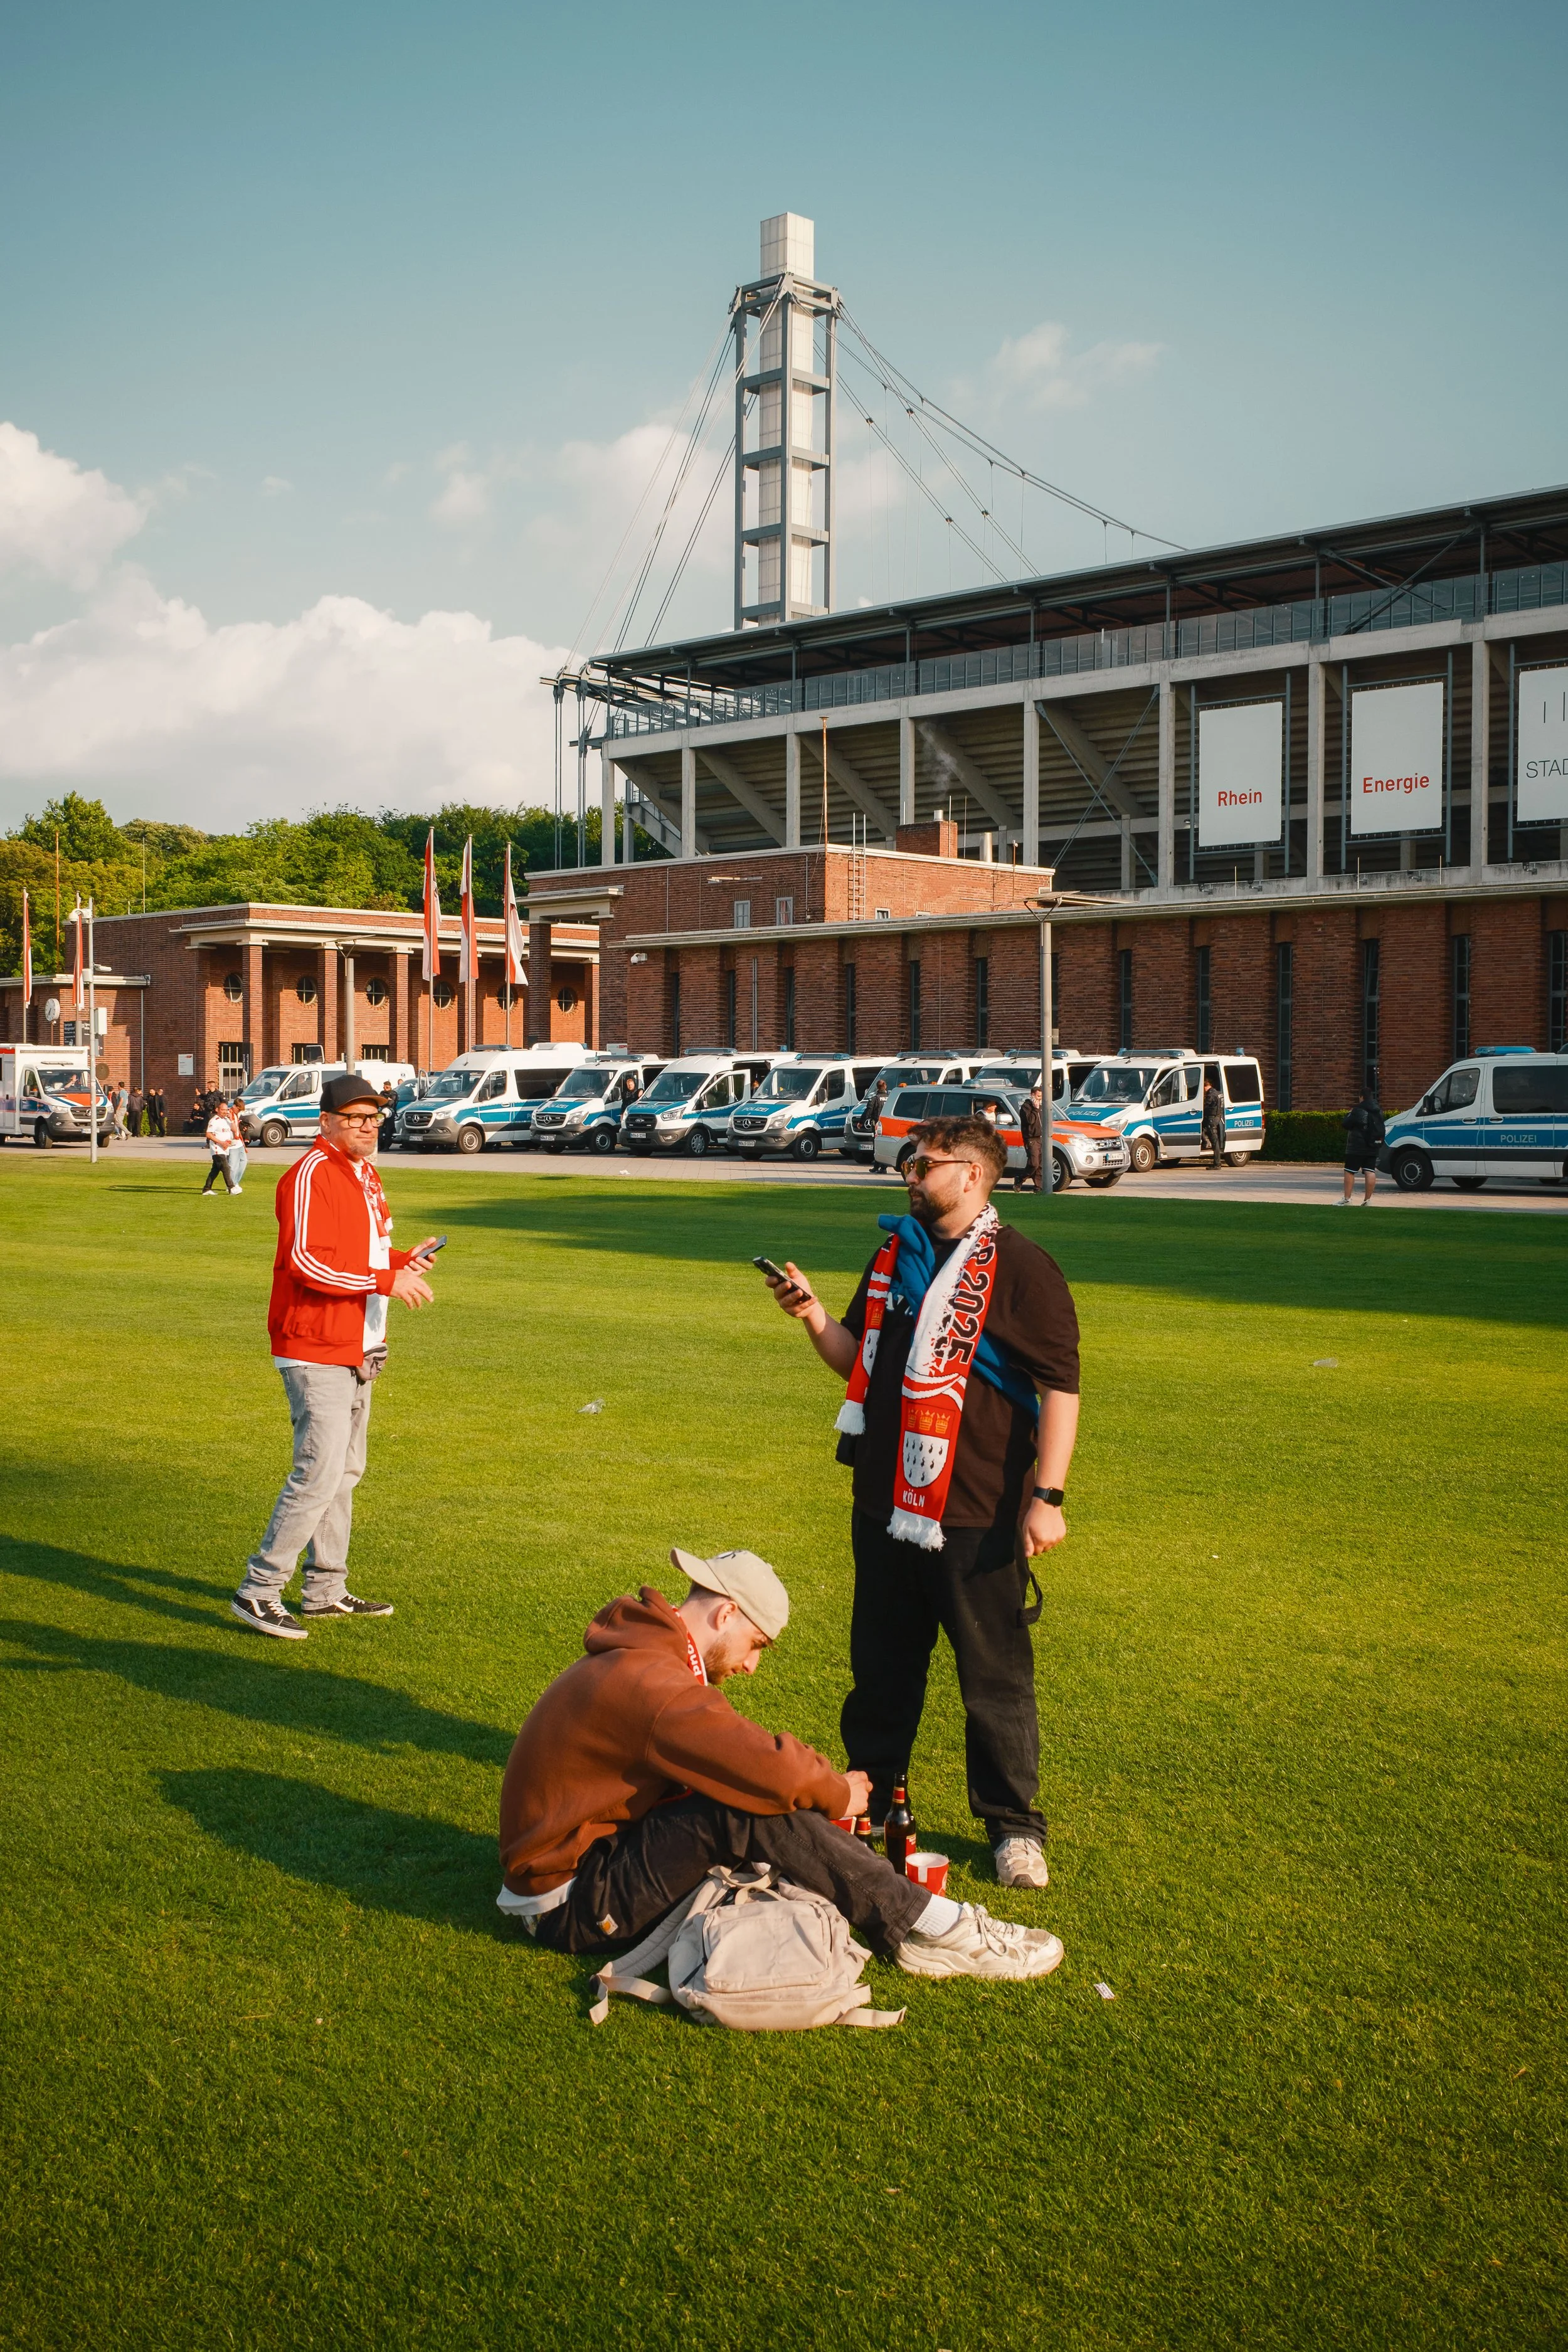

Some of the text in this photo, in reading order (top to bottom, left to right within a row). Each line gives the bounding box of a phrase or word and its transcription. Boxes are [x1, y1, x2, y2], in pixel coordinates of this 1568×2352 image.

[1362, 773, 1430, 795] Energie
[1217, 788, 1263, 807] Rhein
[1234, 1120, 1254, 1128] POLIZEI
[1500, 1135, 1537, 1143] POLIZEI
[935, 1271, 990, 1364] 2025
[903, 1488, 925, 1508] KÖLN
